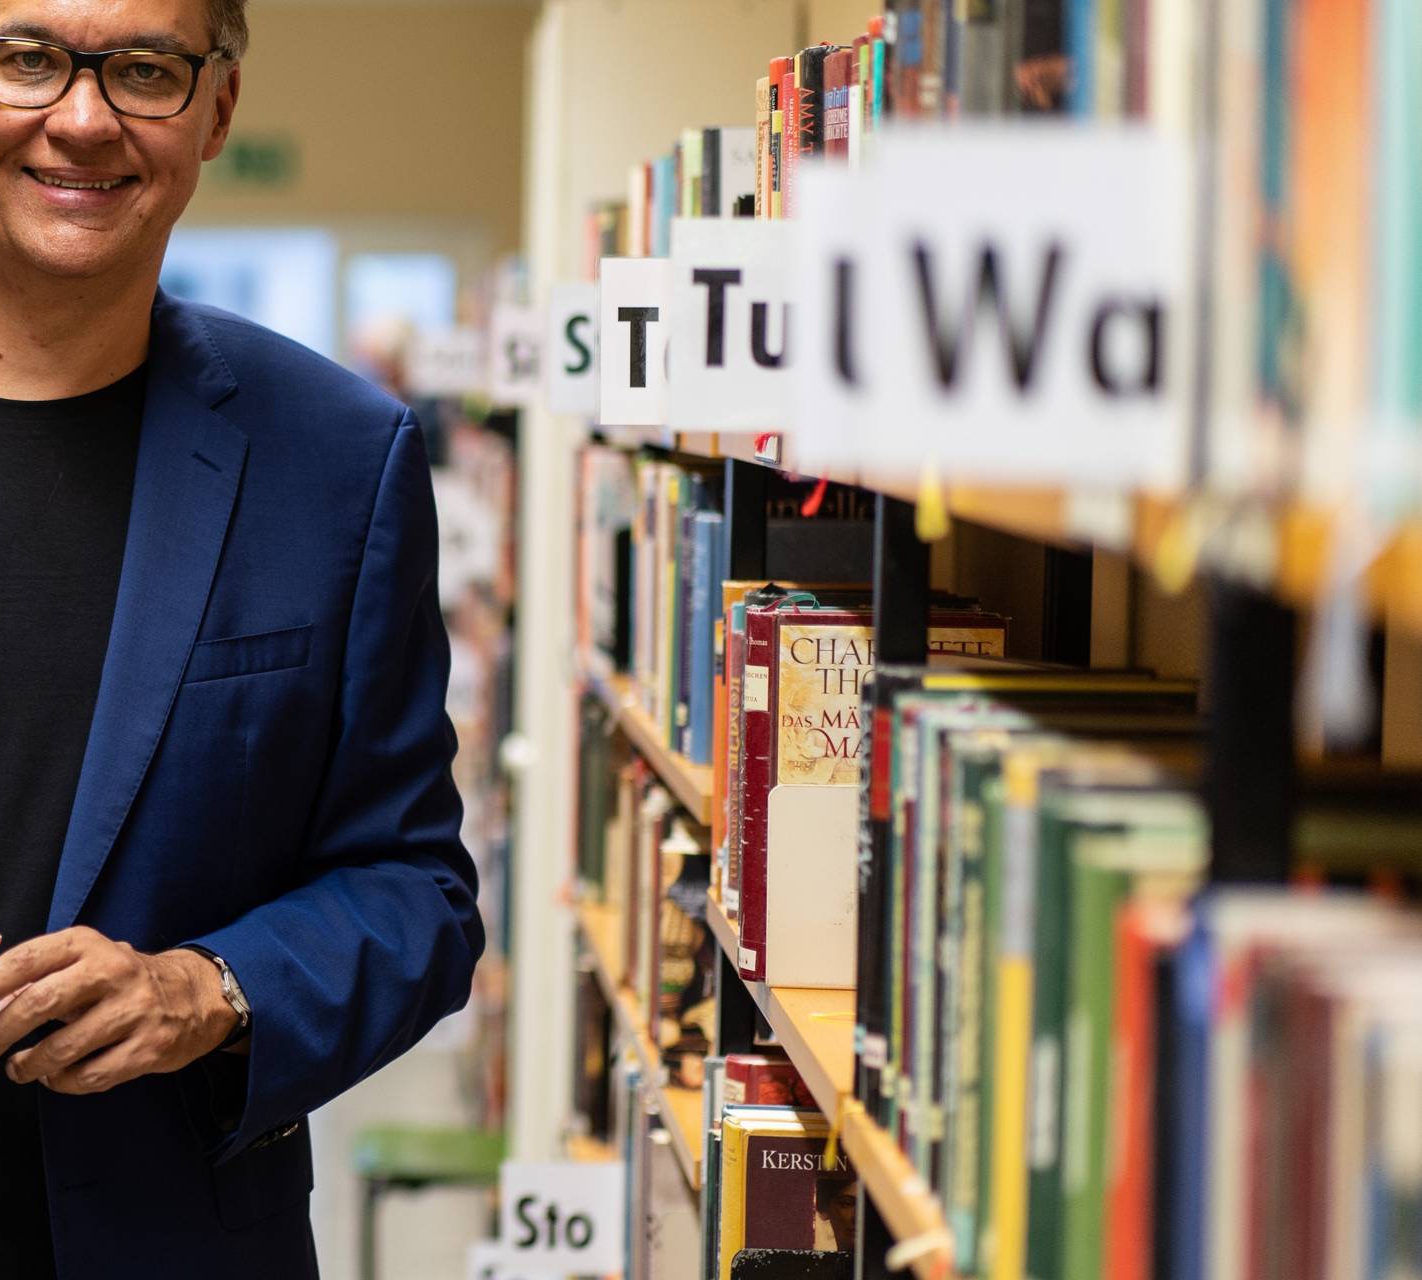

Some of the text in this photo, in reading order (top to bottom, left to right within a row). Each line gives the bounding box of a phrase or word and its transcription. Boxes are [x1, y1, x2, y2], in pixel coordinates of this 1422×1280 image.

[692, 269, 786, 369] Tu
[910, 236, 1164, 396] Wa
[782, 715, 812, 728] DAS
[762, 1150, 847, 1171] KERSTN
[516, 1196, 592, 1249] Sto
